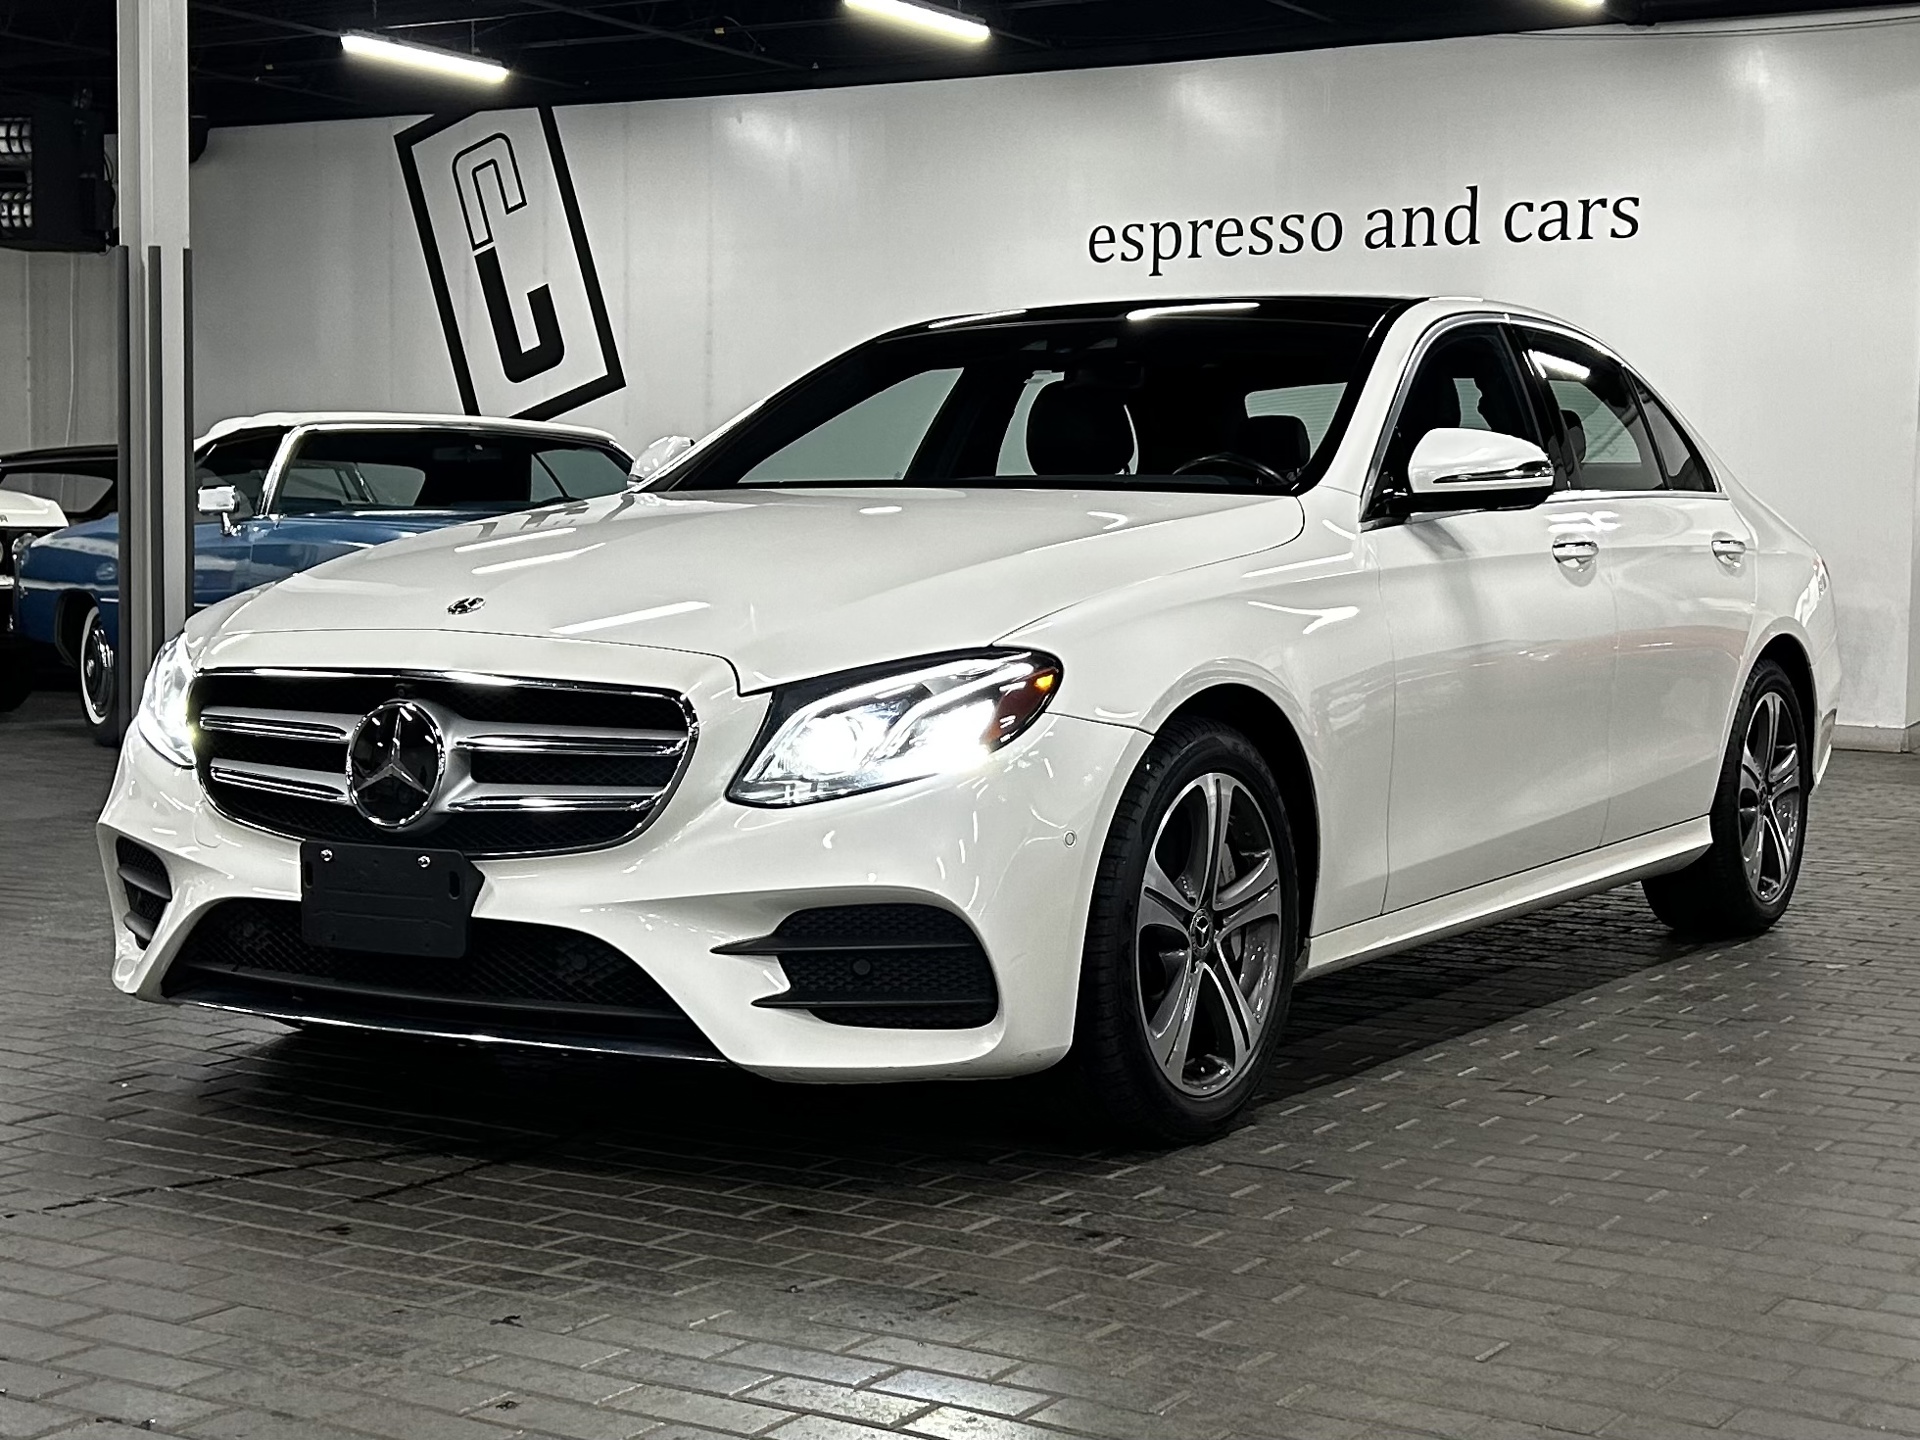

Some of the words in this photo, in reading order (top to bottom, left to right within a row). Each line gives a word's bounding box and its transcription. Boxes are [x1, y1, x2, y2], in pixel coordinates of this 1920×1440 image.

[1088, 213, 1343, 277] espresso
[1364, 185, 1481, 250] and
[1504, 196, 1640, 243] cars
